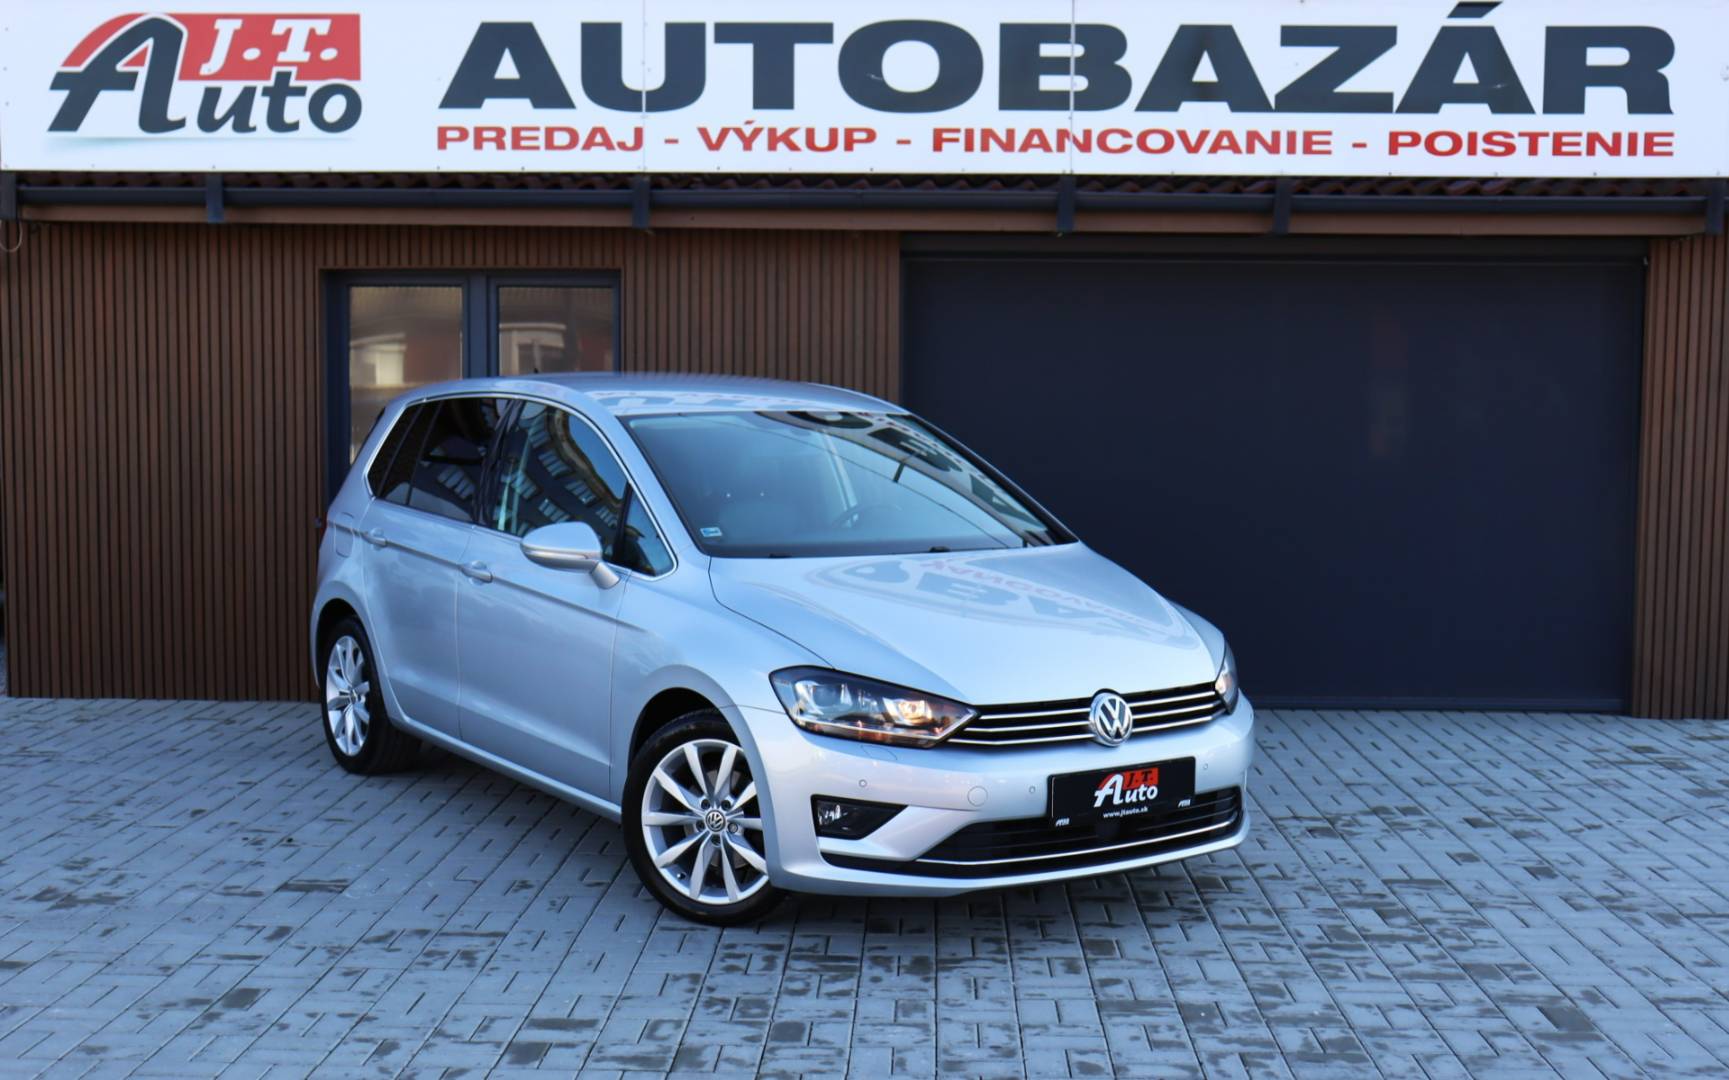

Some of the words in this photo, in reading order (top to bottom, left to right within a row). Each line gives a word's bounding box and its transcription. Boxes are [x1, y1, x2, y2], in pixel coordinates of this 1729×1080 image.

[49, 17, 362, 133] Auto
[199, 18, 338, 76] J.T.
[439, 1, 1675, 114] AUTOBAZÁR
[437, 126, 644, 152] PREDAJ
[696, 119, 877, 153] VÝKUP
[932, 127, 1332, 156] FINANCOVANIE
[1388, 130, 1675, 158] POISTENIE
[1093, 773, 1159, 808] Auto
